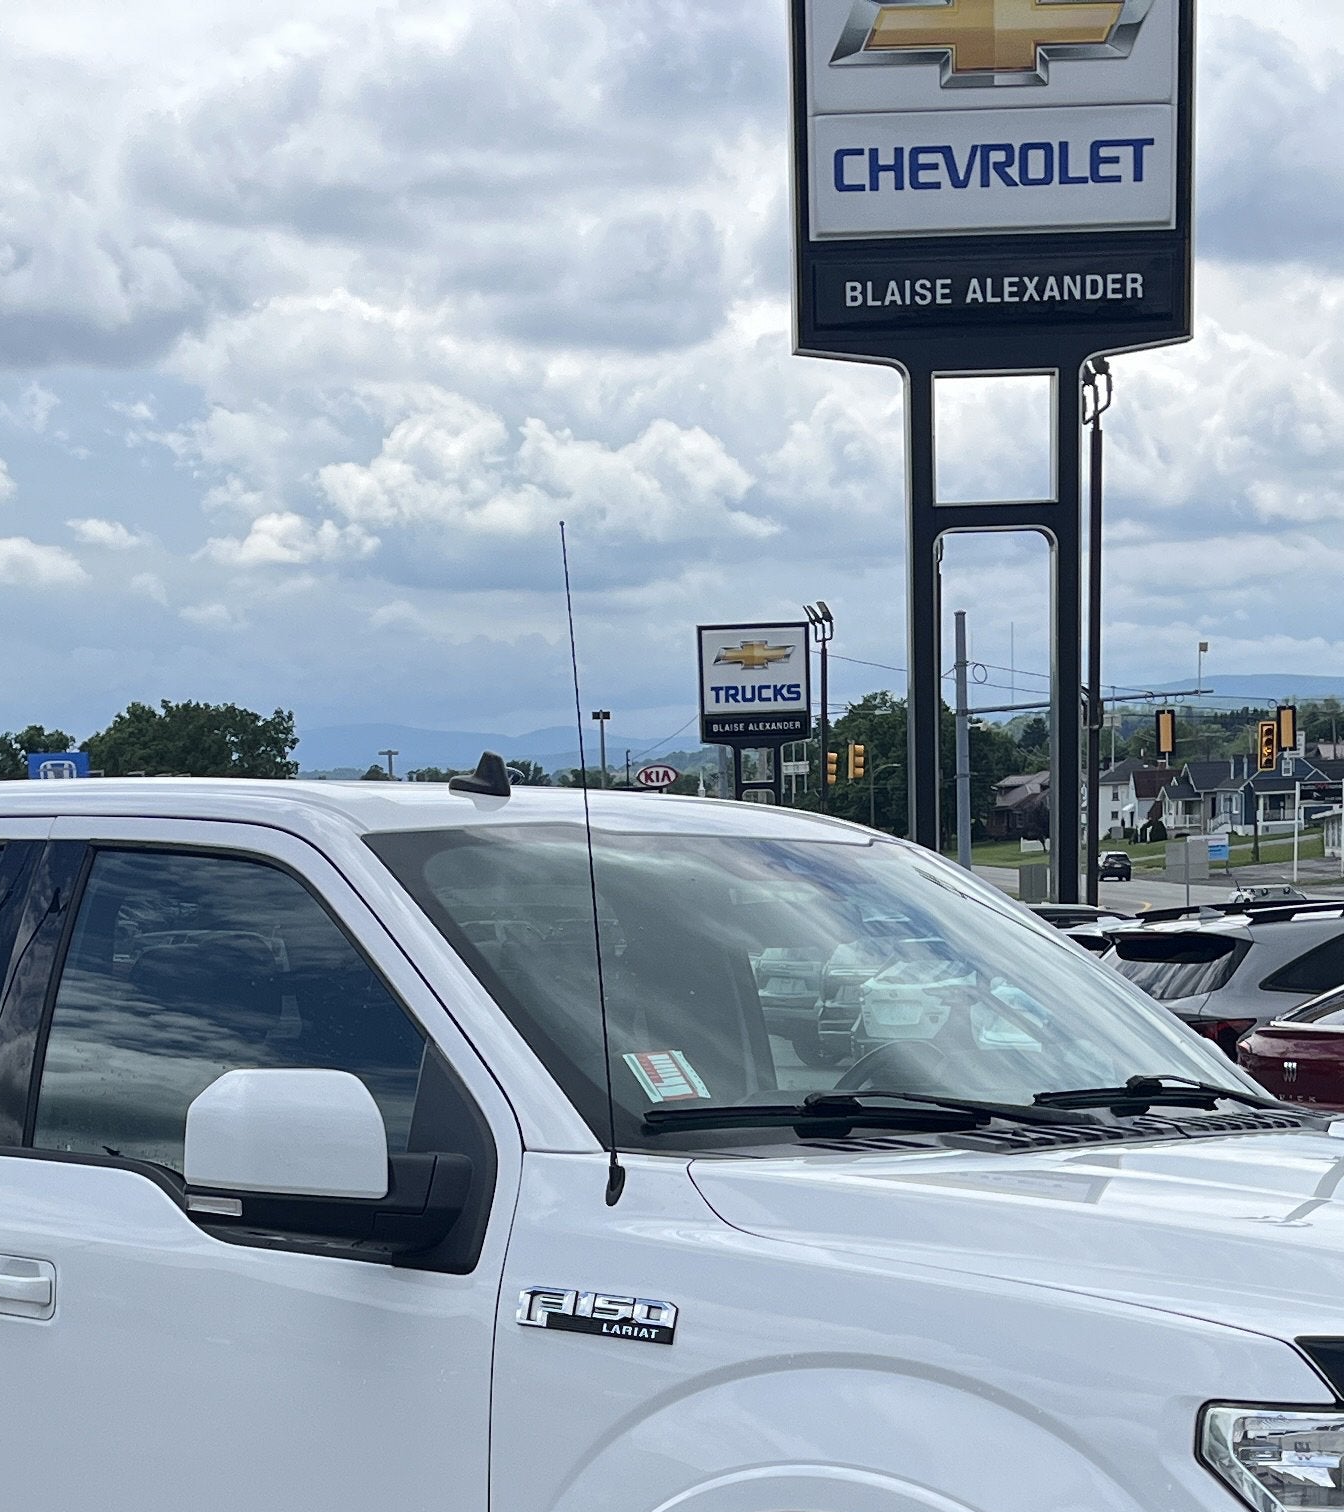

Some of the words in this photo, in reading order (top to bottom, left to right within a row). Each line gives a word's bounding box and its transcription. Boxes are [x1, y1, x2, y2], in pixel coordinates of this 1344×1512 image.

[833, 137, 1155, 192] CHEVROLET
[844, 277, 953, 307] BLAISE
[965, 273, 1144, 303] ALEXANDER
[710, 683, 802, 703] TRUCKS
[712, 722, 745, 732] BLAISE
[748, 721, 801, 731] ALEXANDER
[643, 770, 673, 784] KIA
[602, 1323, 659, 1339] LARIAT
